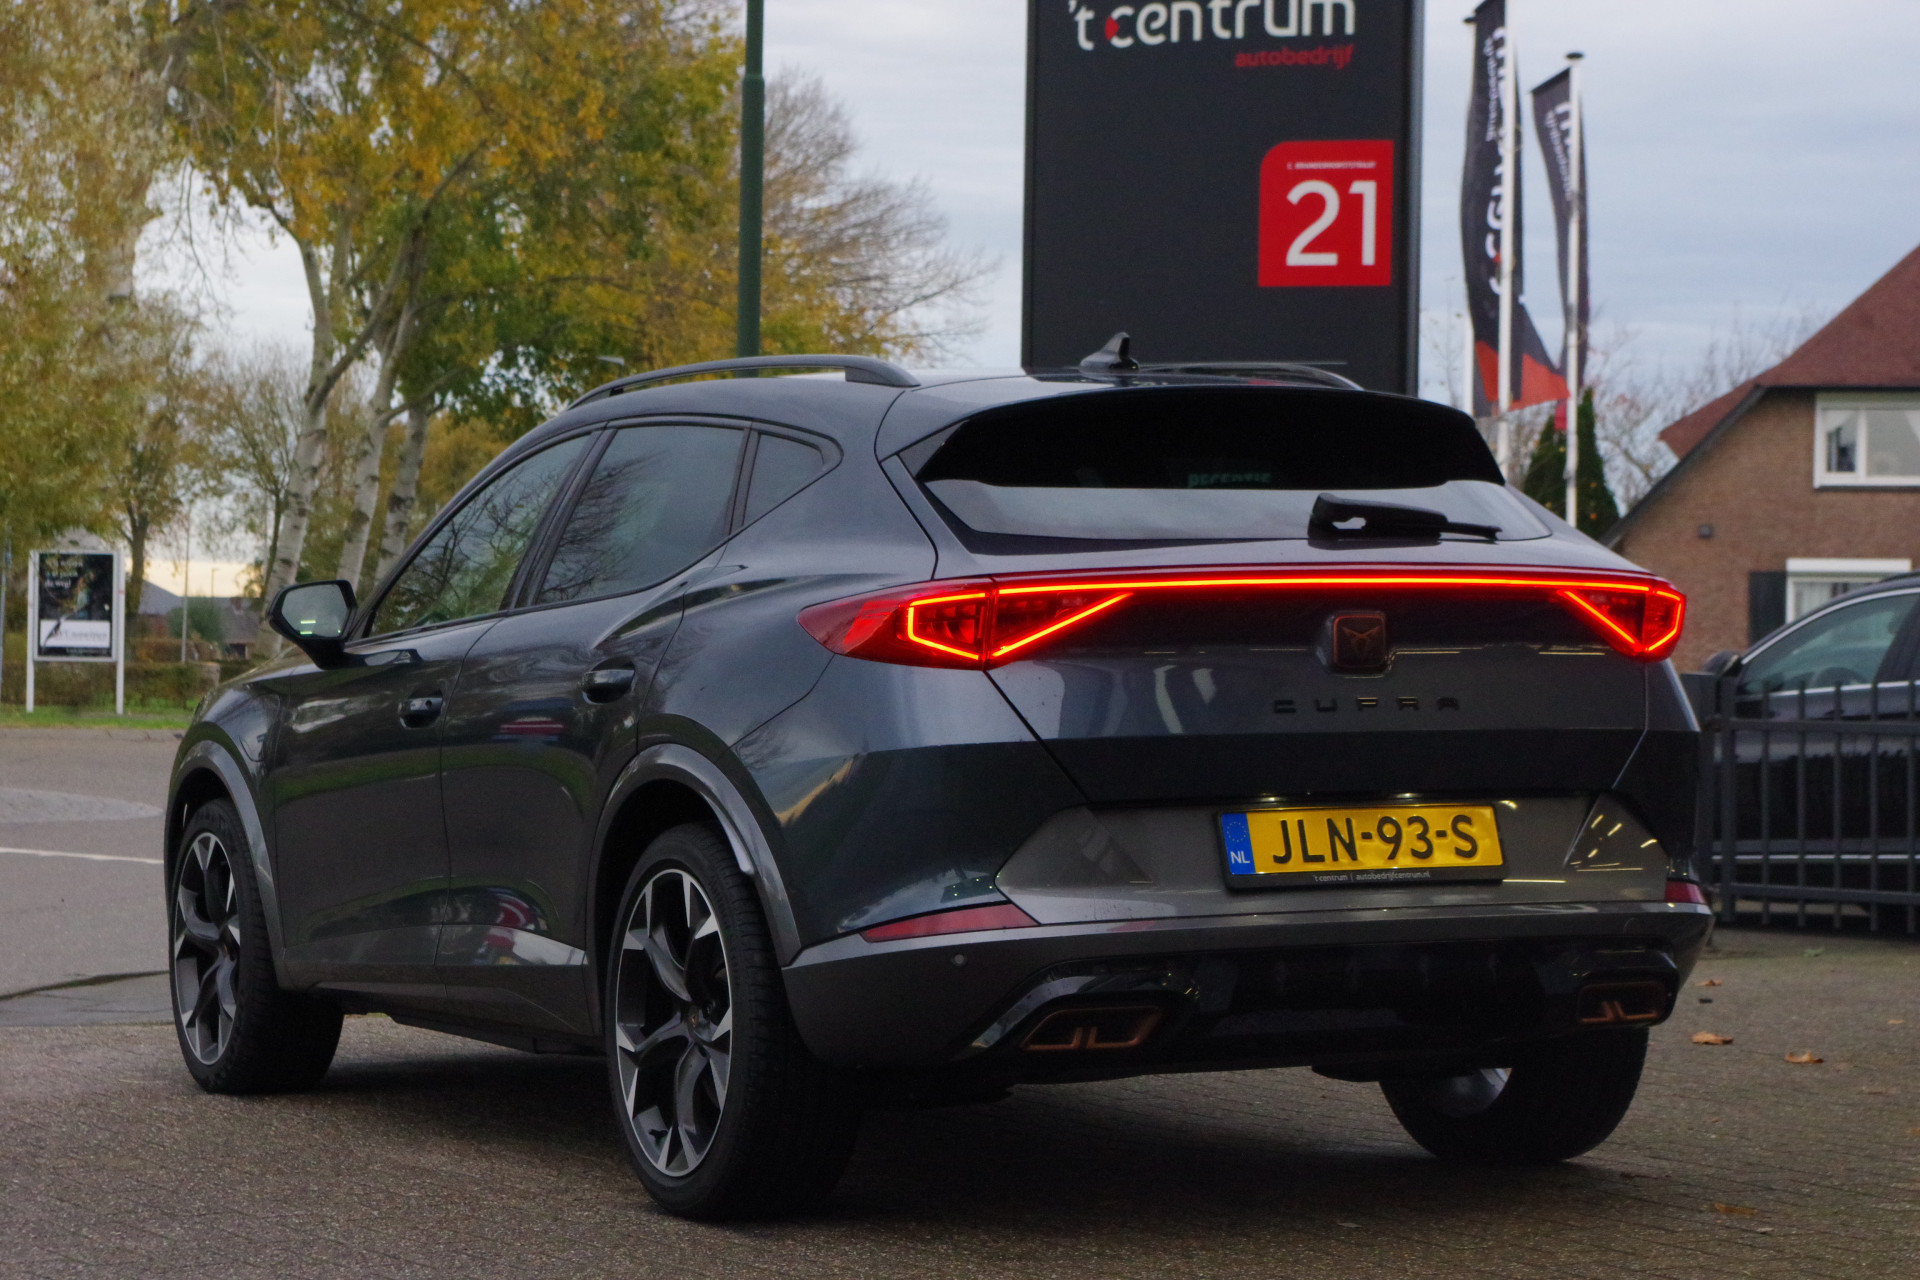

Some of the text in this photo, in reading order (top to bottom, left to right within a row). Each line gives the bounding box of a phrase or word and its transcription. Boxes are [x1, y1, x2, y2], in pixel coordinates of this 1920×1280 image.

[1105, 0, 1356, 49] centrum
[1234, 44, 1355, 69] autobedrijf
[1286, 179, 1377, 267] 21
[1273, 697, 1460, 714] CUPRA
[1273, 814, 1479, 864] JLN-93-S
[1230, 851, 1250, 864] NL
[1356, 871, 1430, 881] autobedrijfcentrum.nl
